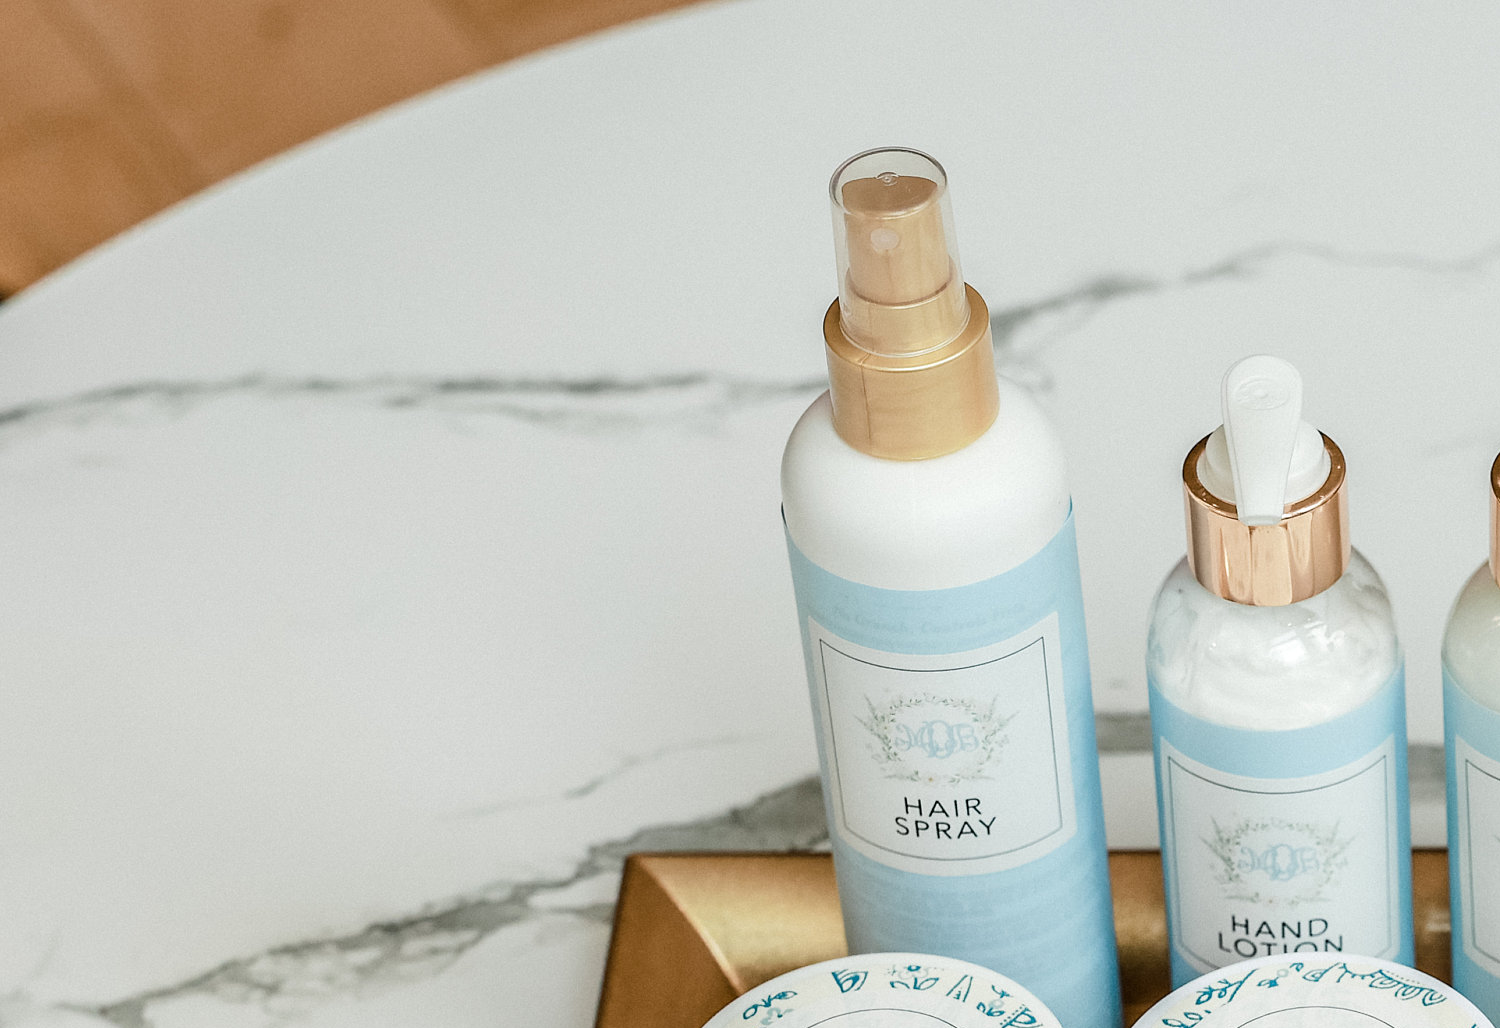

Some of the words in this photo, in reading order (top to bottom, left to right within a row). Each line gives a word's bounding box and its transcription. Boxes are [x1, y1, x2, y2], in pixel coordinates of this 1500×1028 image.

[904, 797, 981, 817] HAIR
[895, 817, 995, 839] SPRAY
[1232, 915, 1328, 938] HAND
